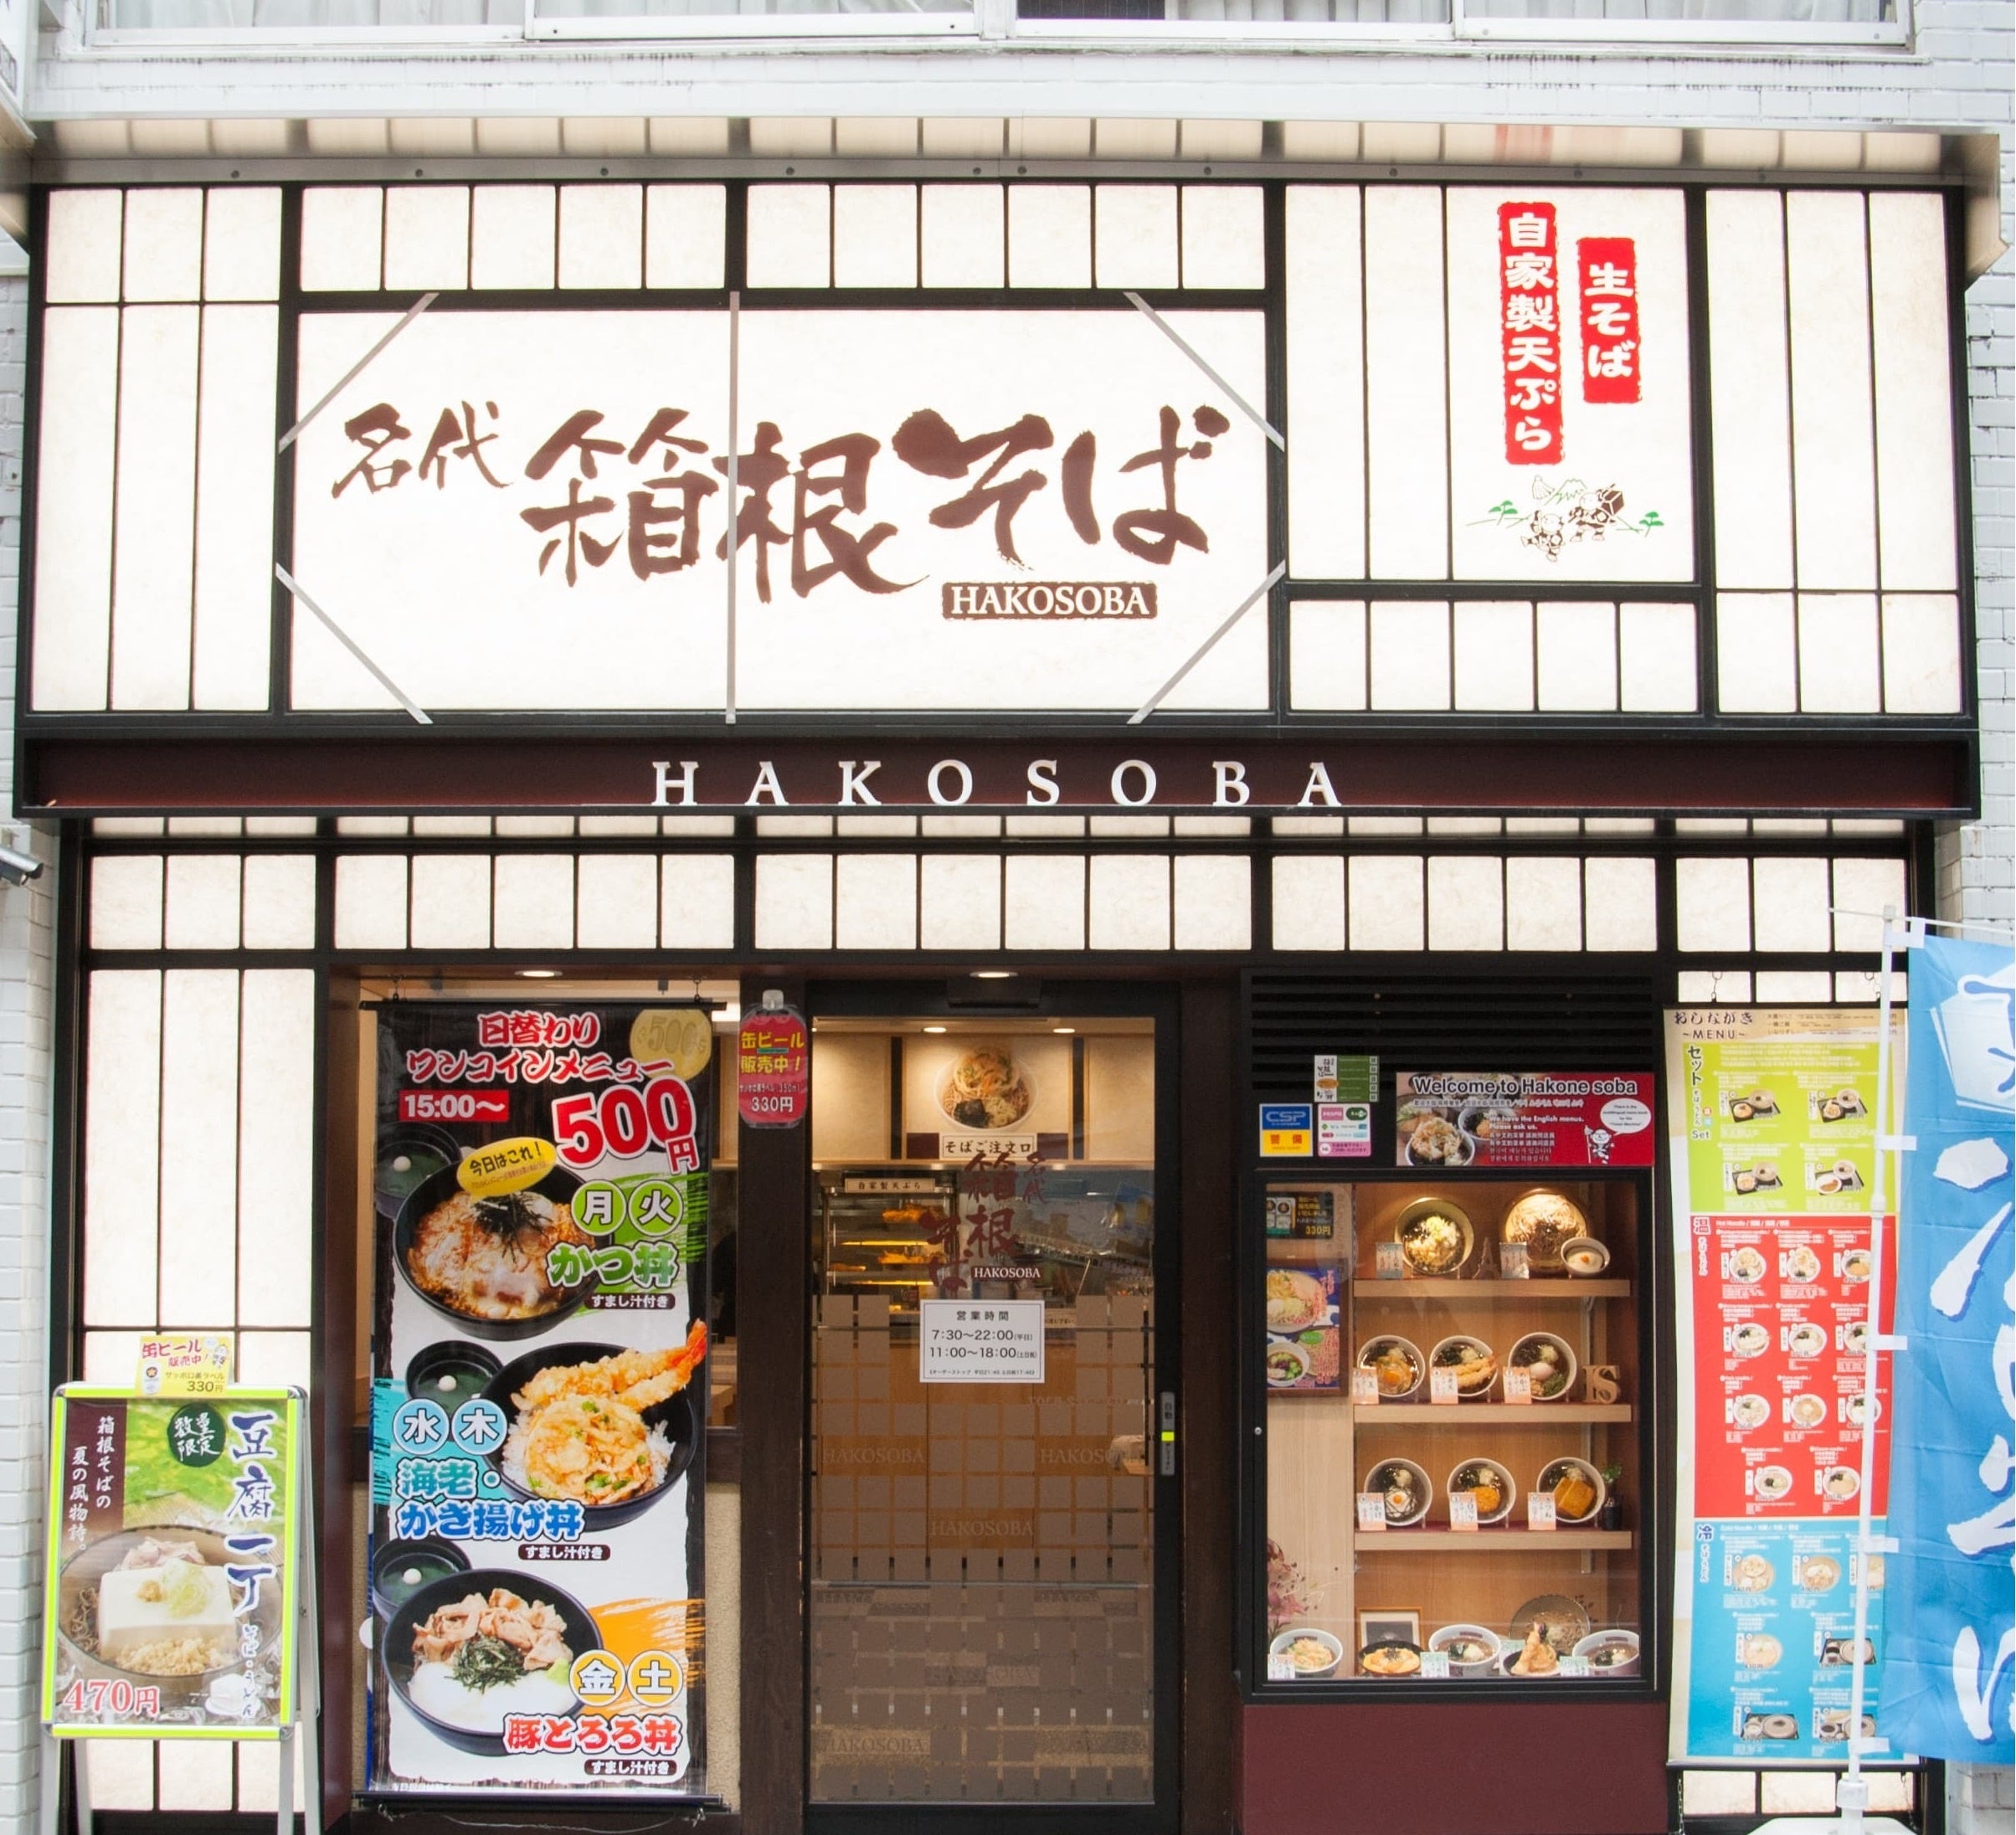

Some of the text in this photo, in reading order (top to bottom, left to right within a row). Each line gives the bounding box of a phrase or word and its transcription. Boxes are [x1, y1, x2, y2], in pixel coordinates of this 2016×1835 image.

[1504, 212, 1558, 451] 自家製天ぷら
[1583, 261, 1638, 379] 生そば
[518, 404, 1231, 604] 箱根そば
[950, 585, 1150, 615] HAKOSOBA
[651, 758, 1342, 807] HAKOSOBA
[478, 1011, 600, 1048] 日替わり
[1674, 1011, 1754, 1025] おしながき
[741, 1031, 805, 1049] 缶ビール
[407, 1050, 673, 1083] ワンコインメニュー
[1688, 1045, 1702, 1086] セット
[1414, 1077, 1638, 1095] Welcome to Hakone soba
[751, 1097, 794, 1113] 330円
[1266, 1111, 1307, 1122] CSP
[1533, 1115, 1558, 1124] English
[945, 1139, 1031, 1154] そばご注文口
[1692, 1130, 1710, 1139] Set
[469, 1141, 543, 1177] 今日はこれ！
[583, 1190, 613, 1225] 月
[638, 1190, 676, 1225] 火
[548, 1242, 679, 1287] かつ丼
[974, 1267, 1041, 1279] HAKOSOBA
[591, 1294, 668, 1308] すまし汁付き
[956, 1310, 1009, 1321] 営業時間
[186, 1380, 224, 1392] 330円
[404, 1408, 441, 1444] 水
[460, 1408, 499, 1444] 木
[95, 1415, 116, 1509] 箱根そばの
[822, 1447, 925, 1464] HAKOSOBA
[224, 1411, 277, 1617] 豆腐一丁
[399, 1502, 585, 1540] かき揚げ丼
[930, 1520, 1033, 1536] HAKOSOBA
[525, 1545, 604, 1560] すまし汁付き
[578, 1658, 616, 1696] 金
[638, 1660, 672, 1695] 土
[63, 1678, 160, 1716] 470円
[505, 1714, 681, 1755] 豚とろろ丼
[590, 1760, 672, 1775] すまし汁付き
